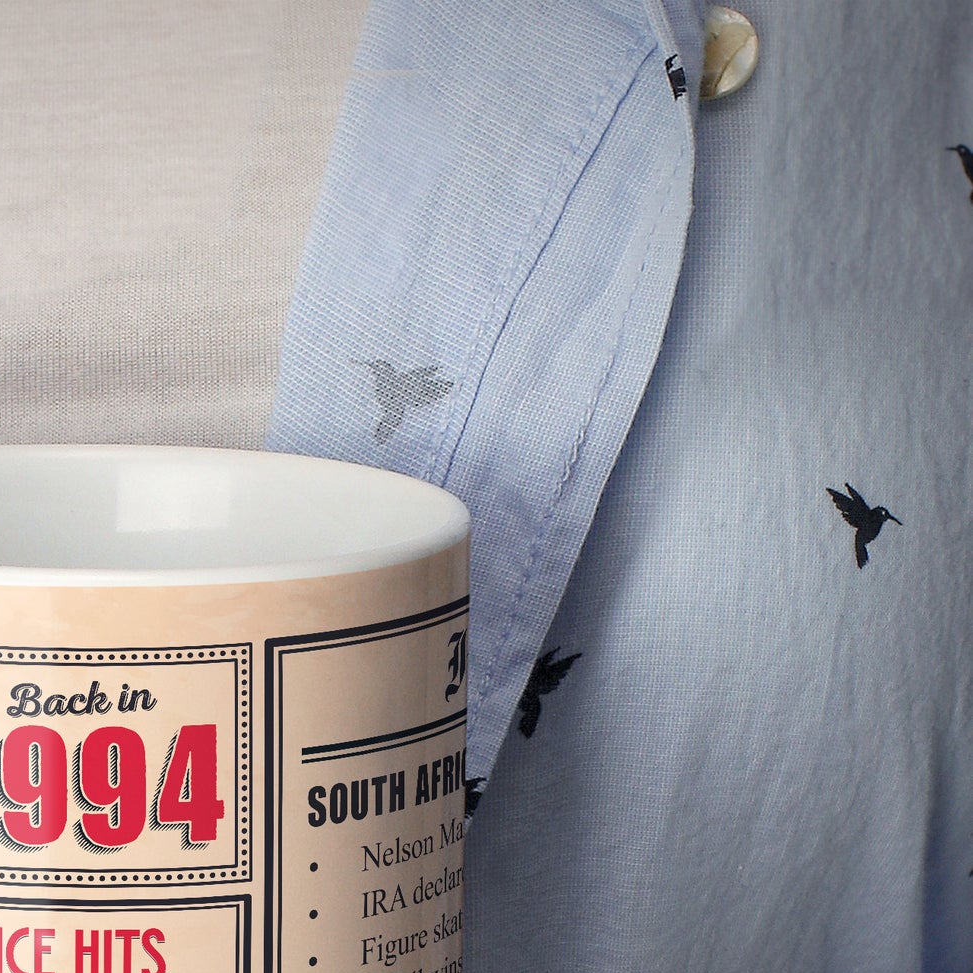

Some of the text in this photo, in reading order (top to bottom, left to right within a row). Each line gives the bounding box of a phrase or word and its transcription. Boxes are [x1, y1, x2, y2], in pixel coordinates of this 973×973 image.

[6, 681, 157, 718] Back in
[307, 770, 406, 828] SOUTH
[360, 834, 435, 872] Nelson
[360, 884, 408, 920] IRA
[360, 930, 428, 967] Figure
